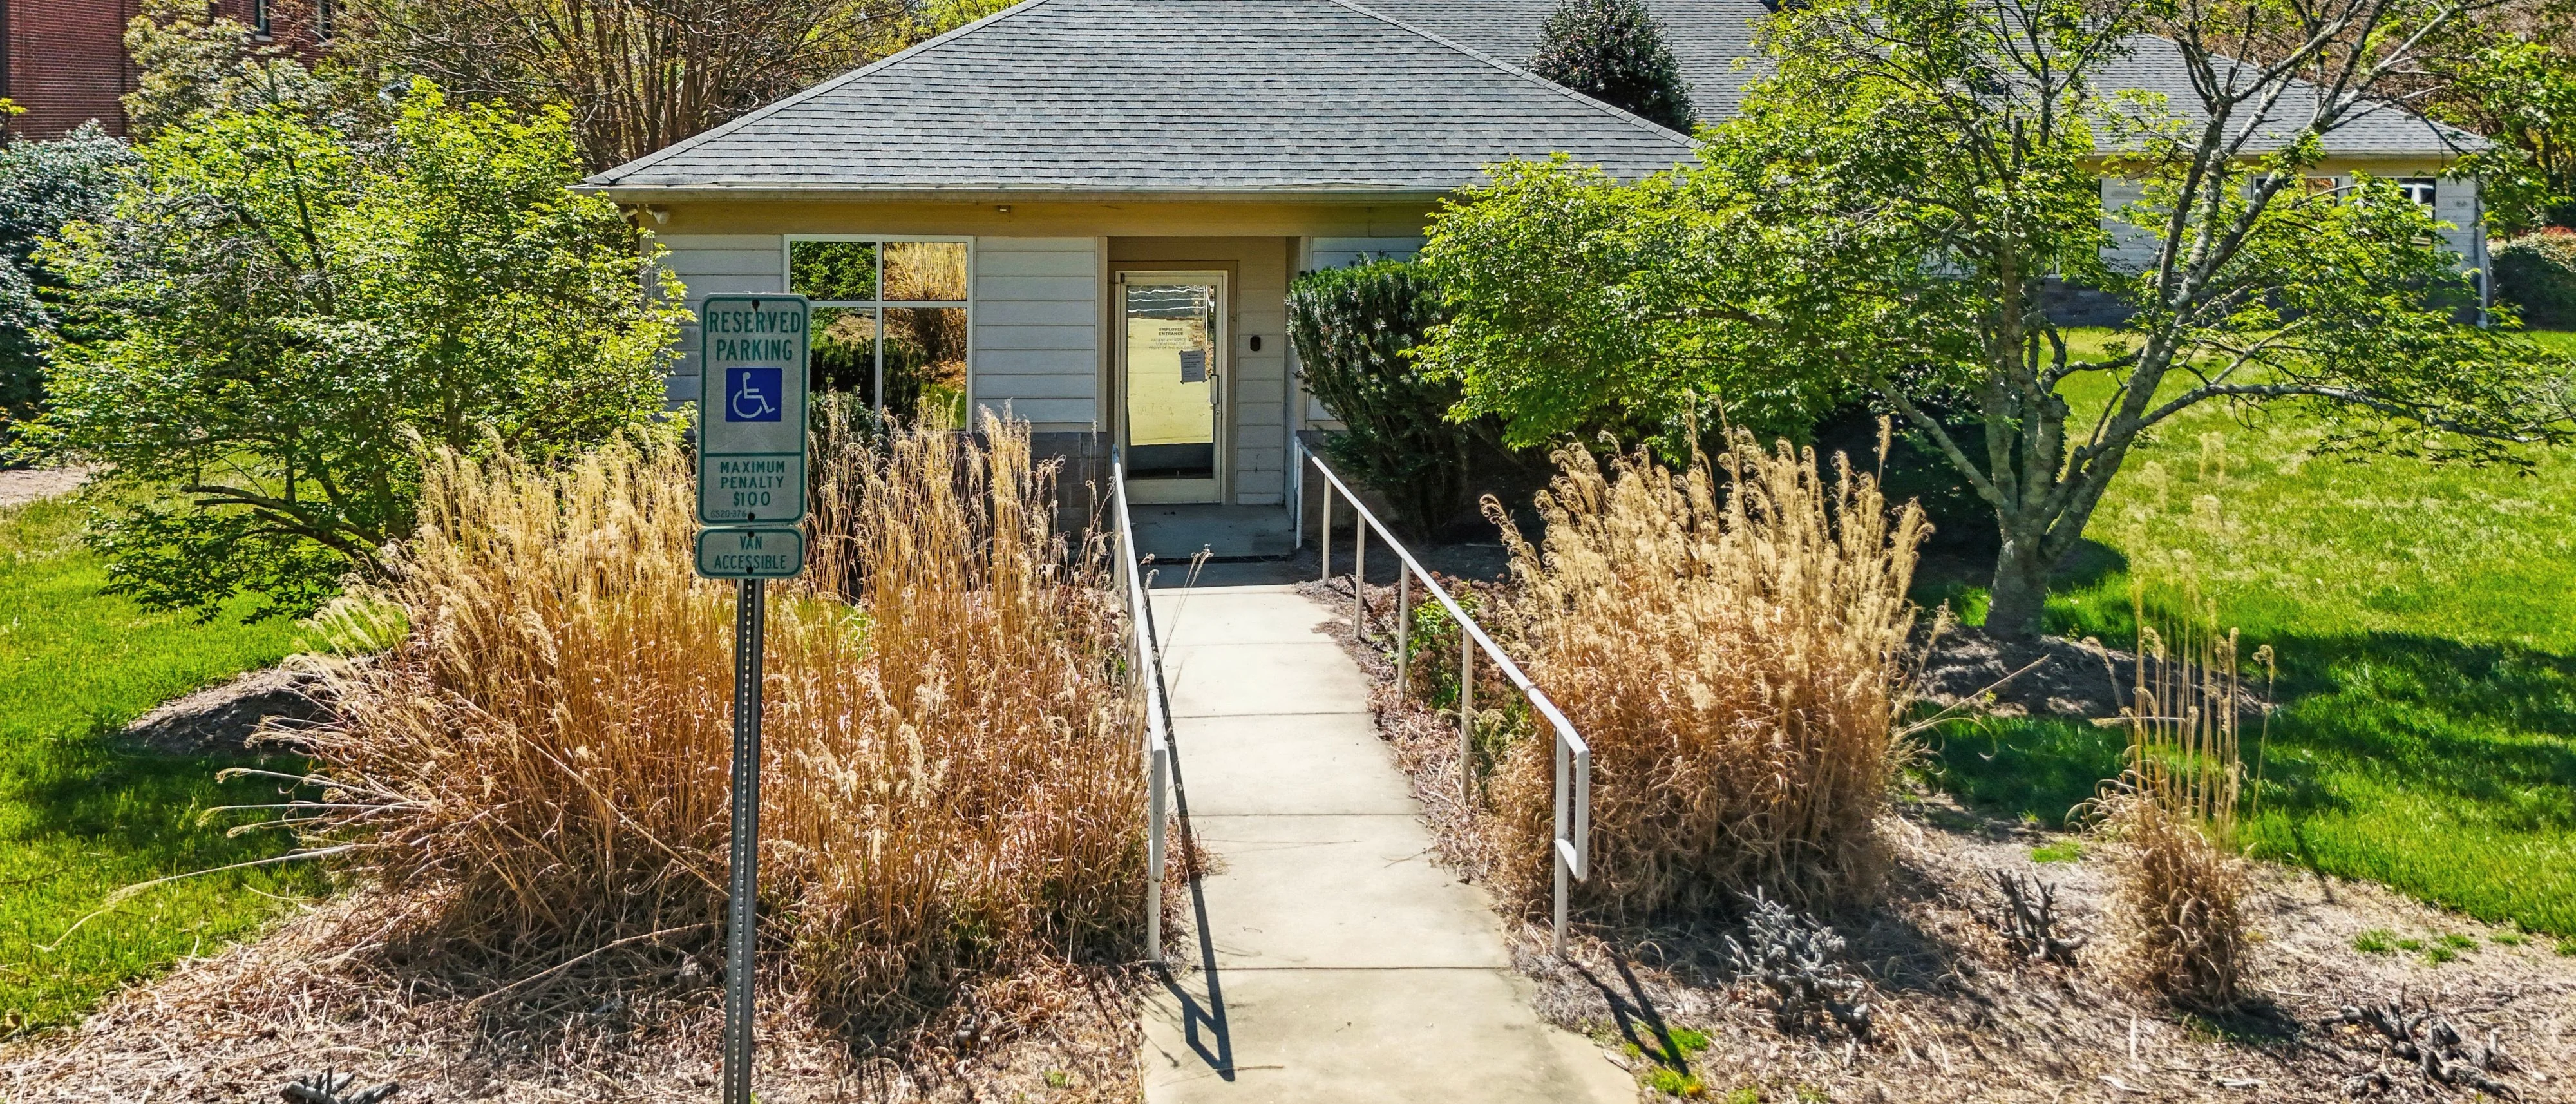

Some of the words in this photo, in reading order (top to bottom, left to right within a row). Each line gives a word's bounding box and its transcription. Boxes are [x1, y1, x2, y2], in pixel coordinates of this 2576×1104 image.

[709, 311, 800, 333] RESERVED
[716, 339, 793, 361] PARKING
[720, 461, 785, 474] MAXIMUM
[721, 476, 784, 489] PENALTY
[733, 491, 770, 506] $100
[739, 536, 762, 550] VAN
[714, 555, 786, 569] ACCESSIBLE
